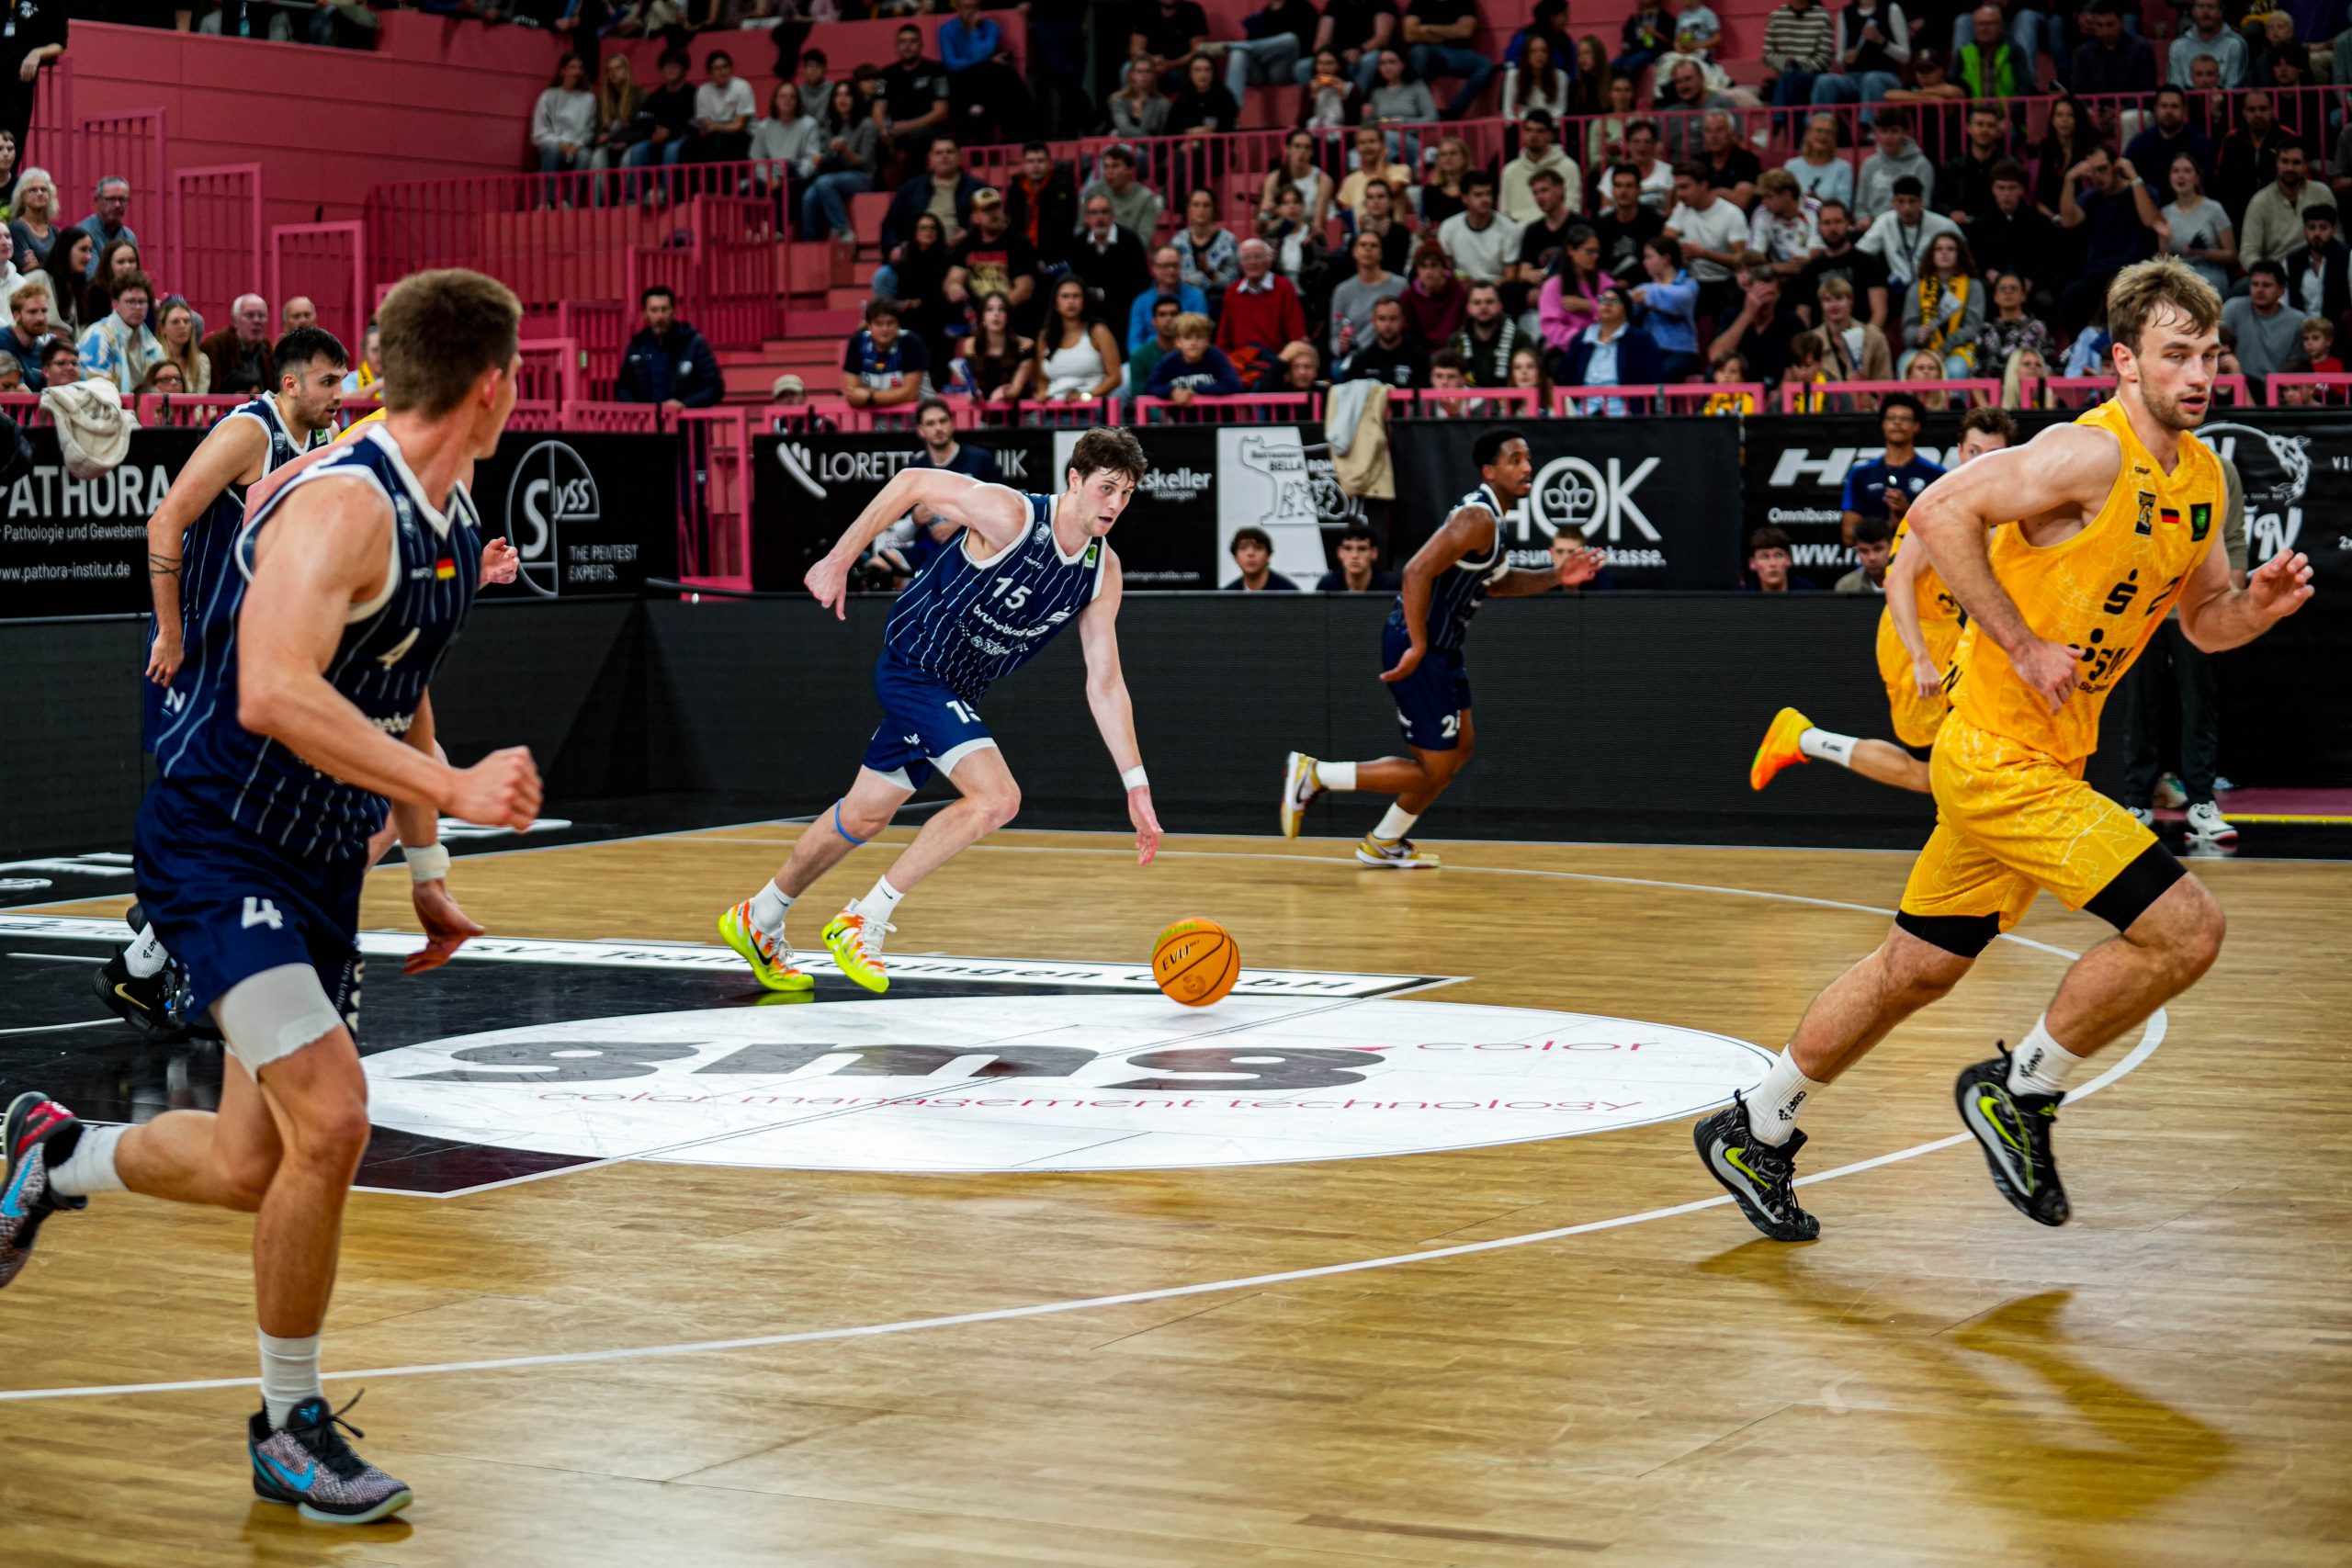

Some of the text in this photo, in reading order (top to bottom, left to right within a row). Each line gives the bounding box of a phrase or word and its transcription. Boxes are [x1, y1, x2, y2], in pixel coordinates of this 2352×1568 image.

[820, 450, 925, 481] LORETT
[1269, 460, 1304, 472] BELLA
[0, 464, 172, 518] ATHORA
[4, 524, 64, 546] Pathologie
[67, 522, 88, 540] und
[568, 544, 639, 561] THE PENTEST
[992, 577, 1034, 610] 15
[242, 897, 283, 929] 4
[1417, 1040, 1660, 1051] color
[390, 1041, 1385, 1091] sms
[538, 1091, 1643, 1111] color management technology
